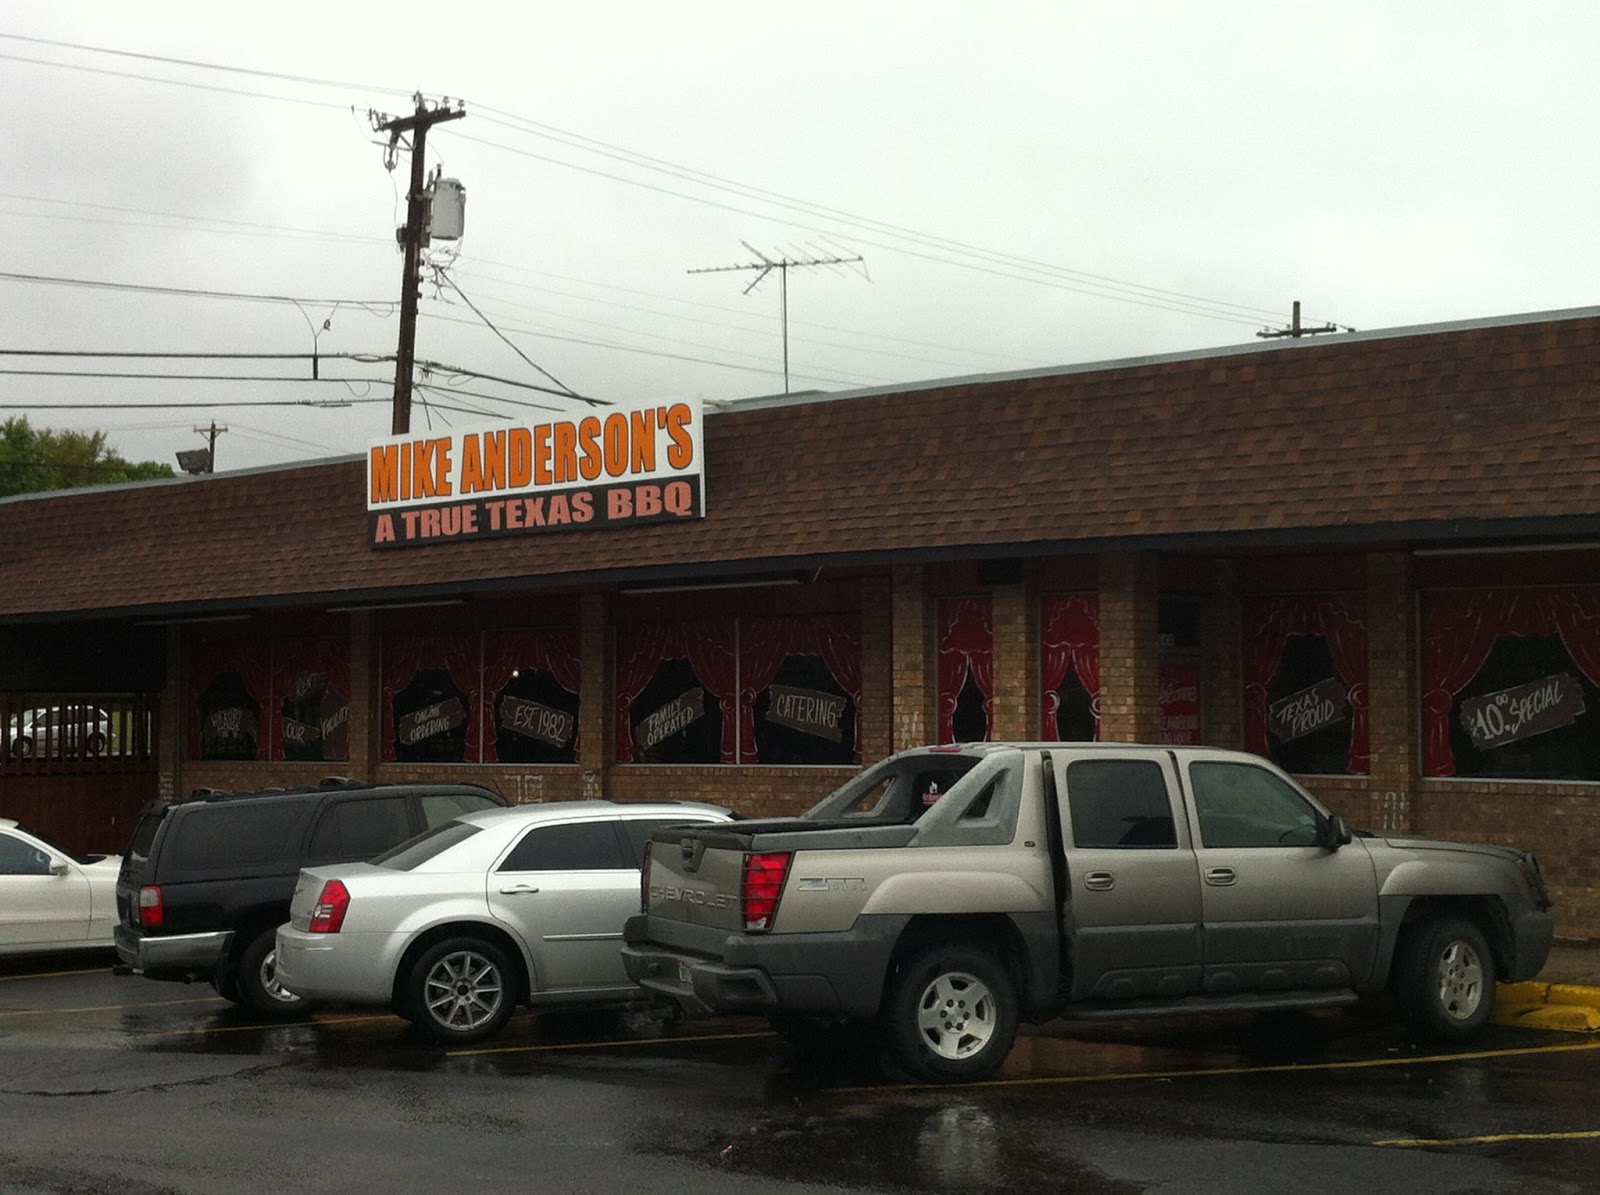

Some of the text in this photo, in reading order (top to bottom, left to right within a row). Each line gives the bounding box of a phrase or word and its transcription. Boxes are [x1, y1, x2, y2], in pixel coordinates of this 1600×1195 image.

[371, 403, 694, 504] MIKE ANDERSON'S
[375, 481, 693, 543] A TRUE TEXAS BBQ
[648, 699, 683, 731] FAMILY
[776, 694, 839, 729] CATERING
[1276, 688, 1319, 724] TEXAS
[1291, 700, 1335, 738] PROUD
[1509, 680, 1564, 735] SPECIAL
[285, 721, 306, 743] OUR
[410, 715, 450, 741] ORDERING
[537, 709, 568, 743] 1982
[647, 706, 694, 746] OPERATED
[650, 885, 739, 910] CHEVROLET
